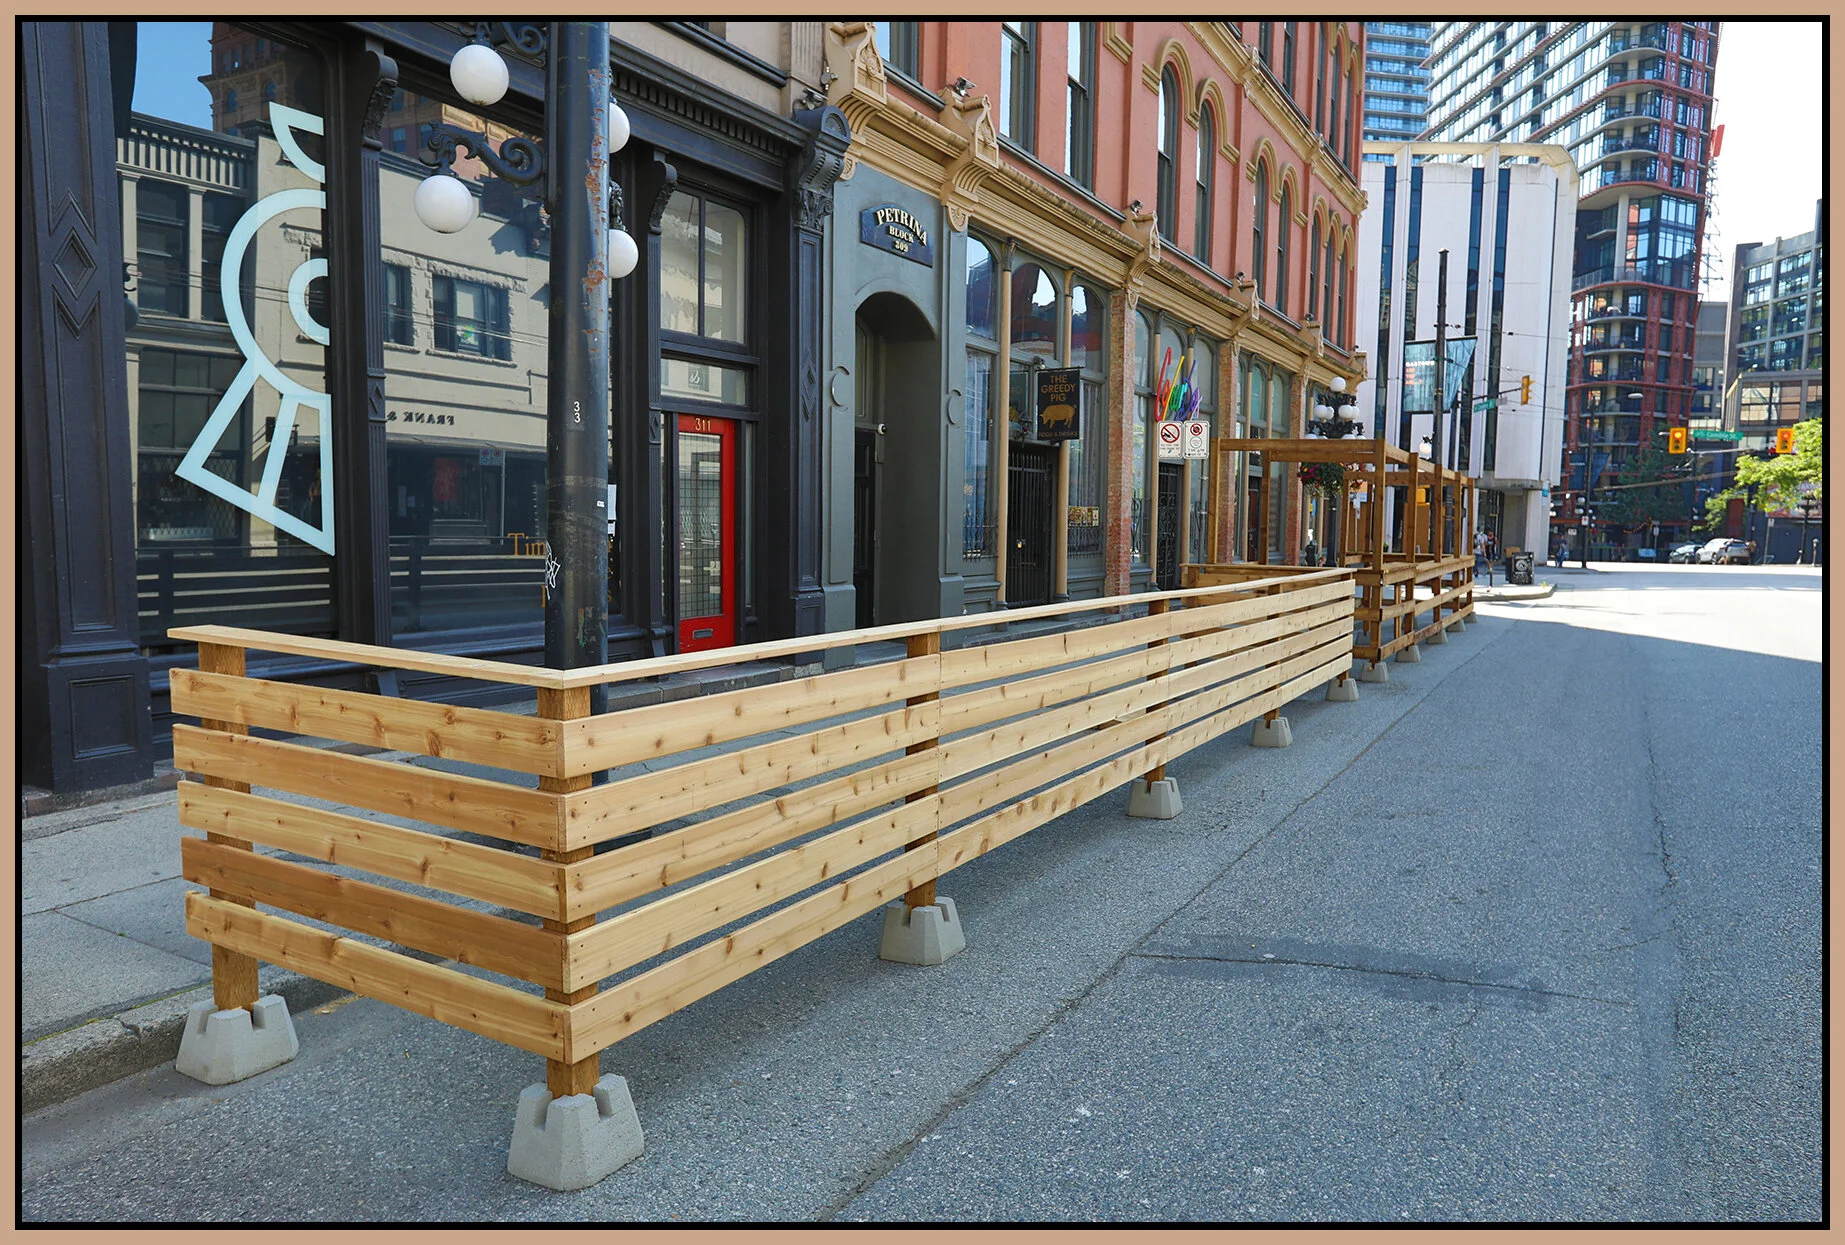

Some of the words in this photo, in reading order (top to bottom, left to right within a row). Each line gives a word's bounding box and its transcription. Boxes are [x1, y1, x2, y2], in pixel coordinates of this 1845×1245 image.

[876, 207, 927, 246] PETRINA
[889, 225, 914, 243] BLOCK
[894, 240, 909, 252] 309
[1050, 375, 1067, 384] THE
[1041, 384, 1076, 393] GREEDY
[1050, 394, 1066, 402] PIG
[695, 417, 711, 432] 311
